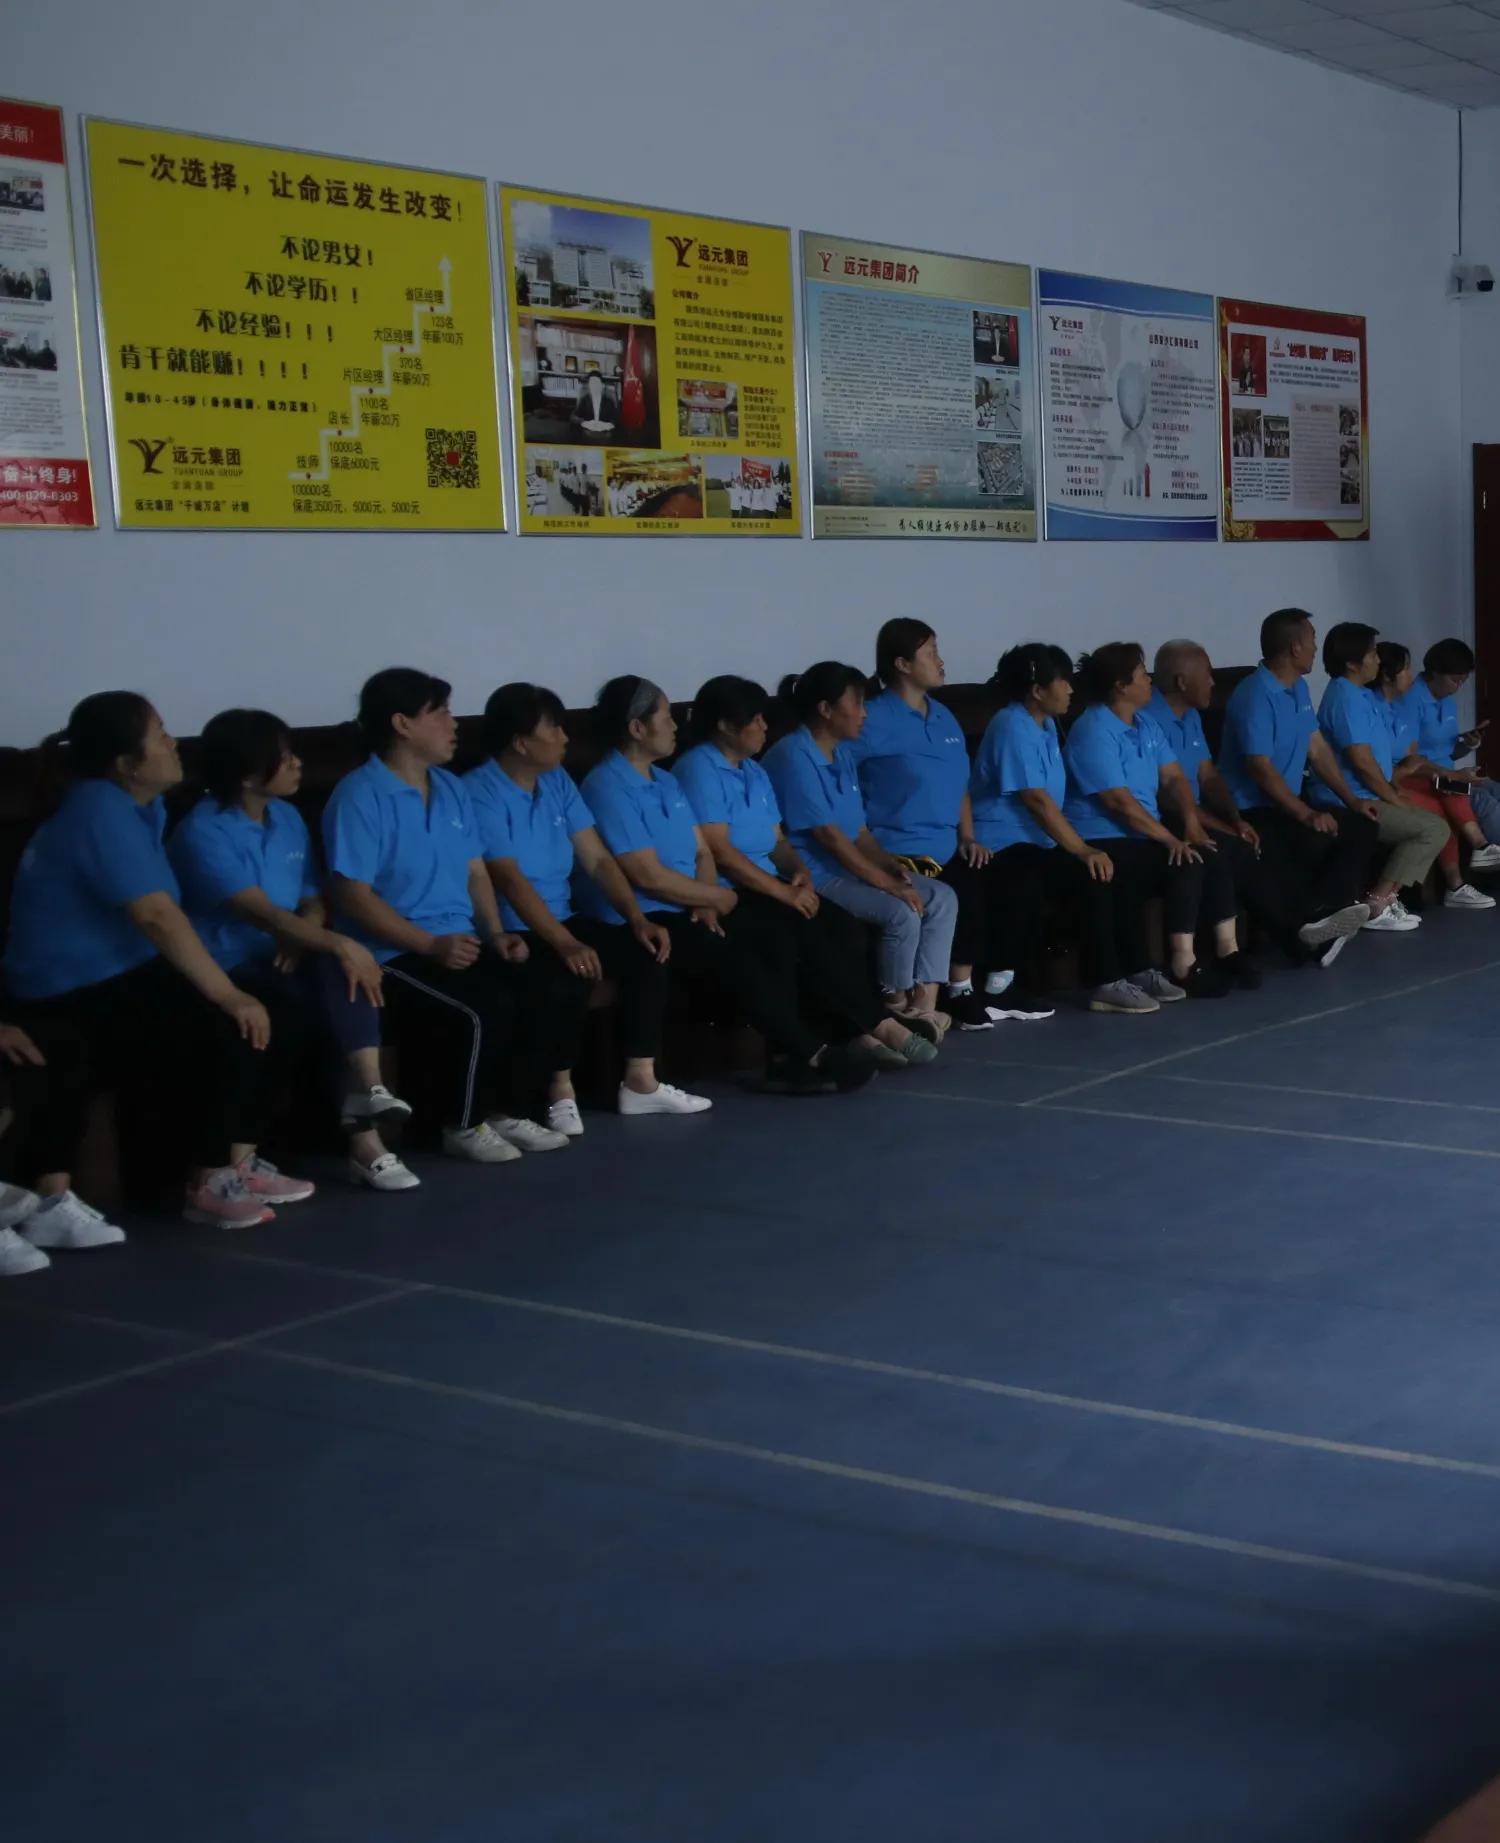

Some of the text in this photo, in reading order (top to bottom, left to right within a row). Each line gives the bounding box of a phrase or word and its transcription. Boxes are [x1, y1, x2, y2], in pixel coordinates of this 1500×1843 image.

[844, 256, 920, 284] 远元集团简介
[374, 328, 414, 344] 大区经理
[172, 446, 241, 466] 远元集团
